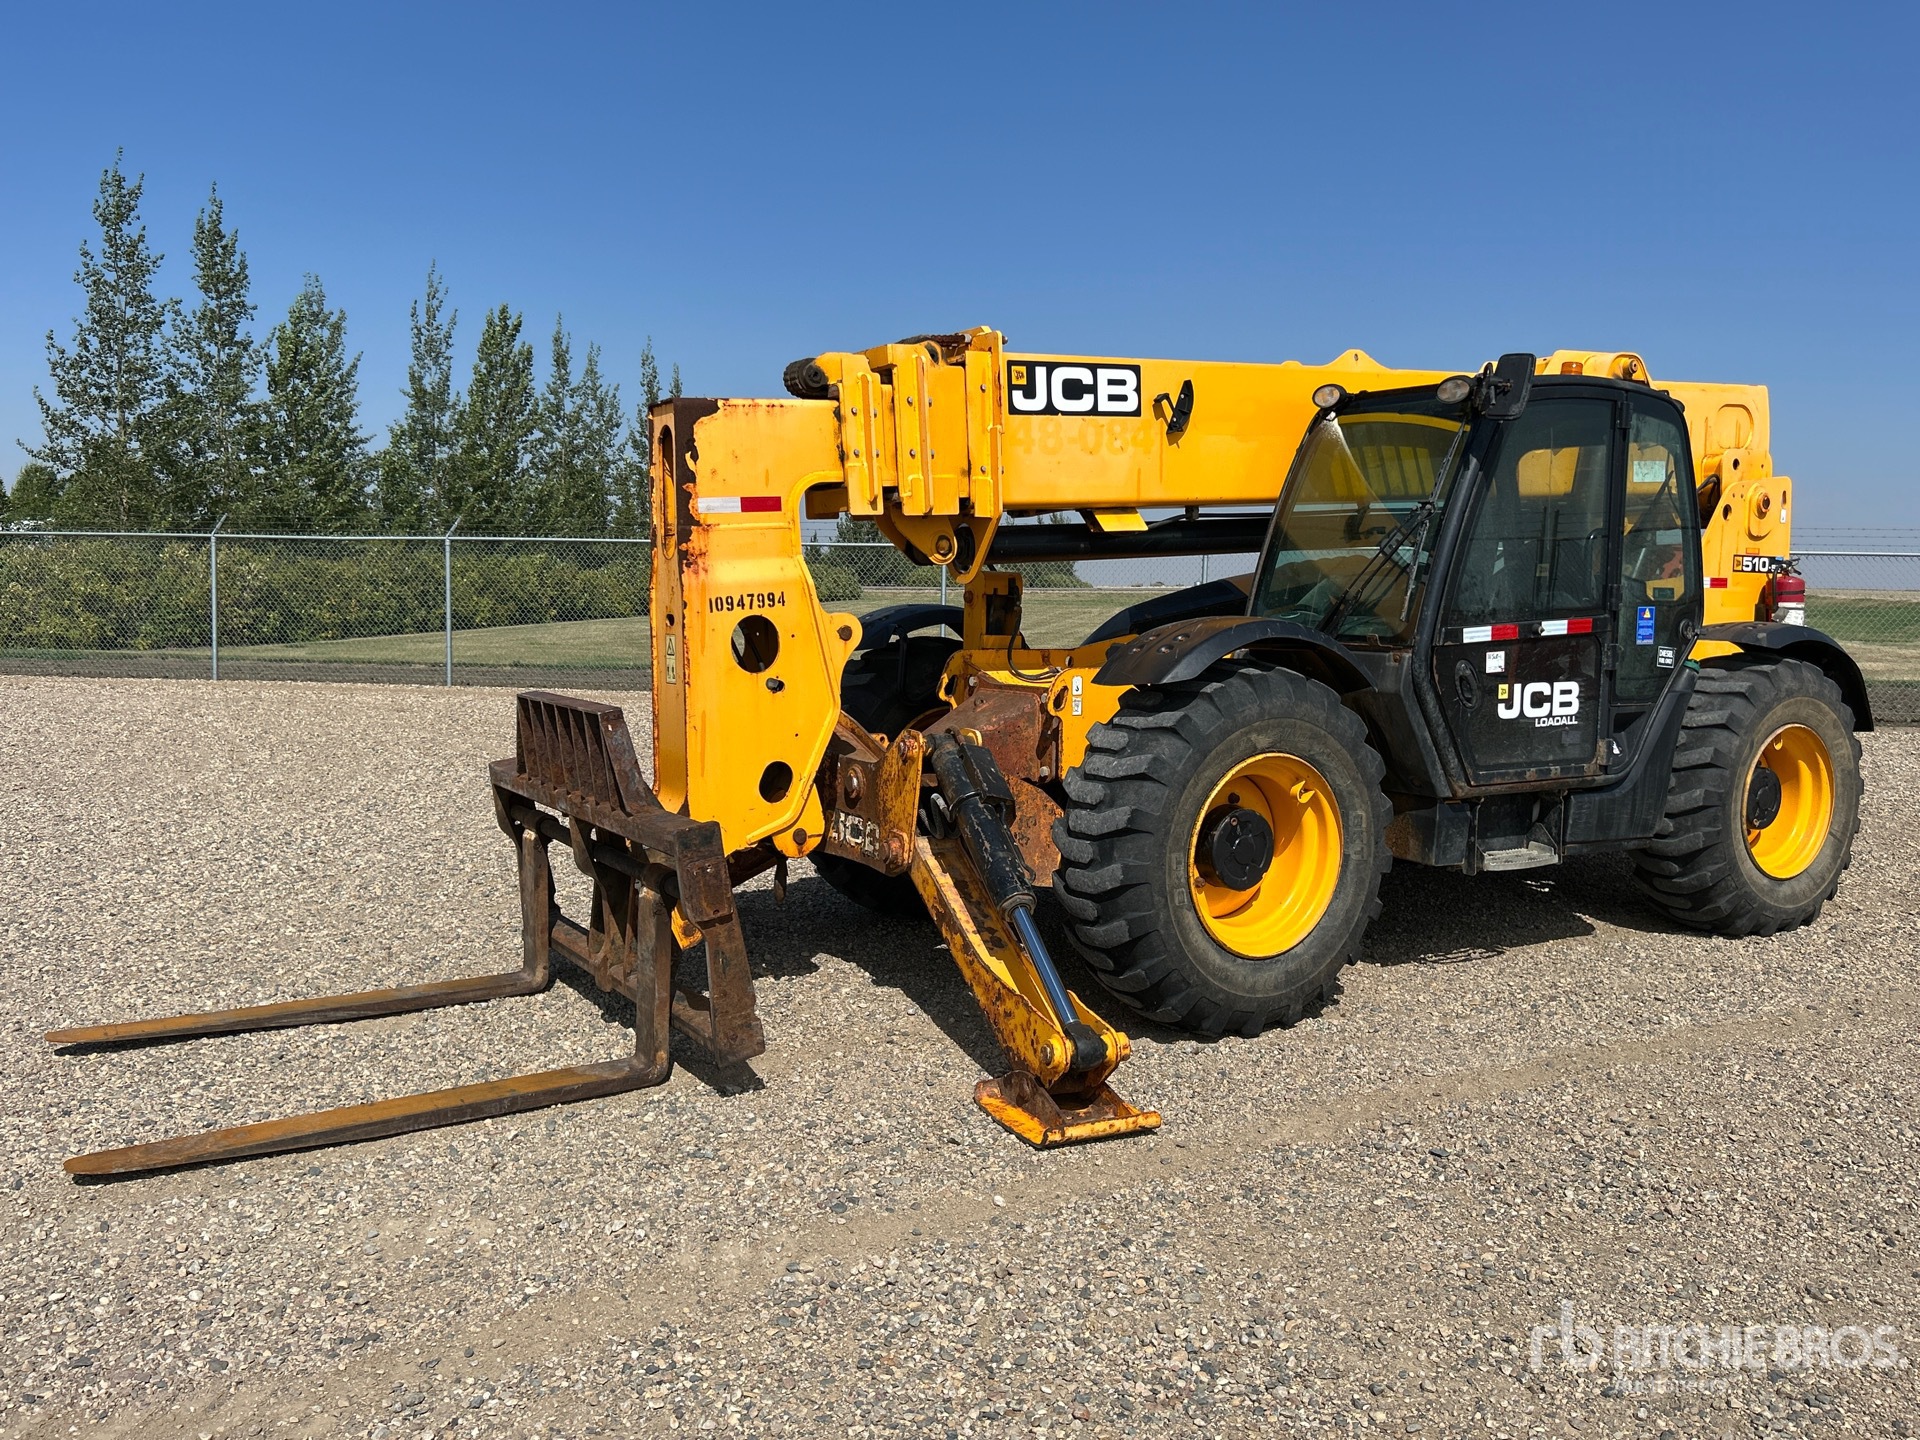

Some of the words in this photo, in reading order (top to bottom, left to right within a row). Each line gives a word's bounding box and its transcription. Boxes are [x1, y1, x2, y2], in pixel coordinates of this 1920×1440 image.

[1012, 366, 1139, 412] JCB
[709, 591, 786, 613] 10947994
[1497, 681, 1580, 719] JCB
[1535, 716, 1578, 727] LOADALL
